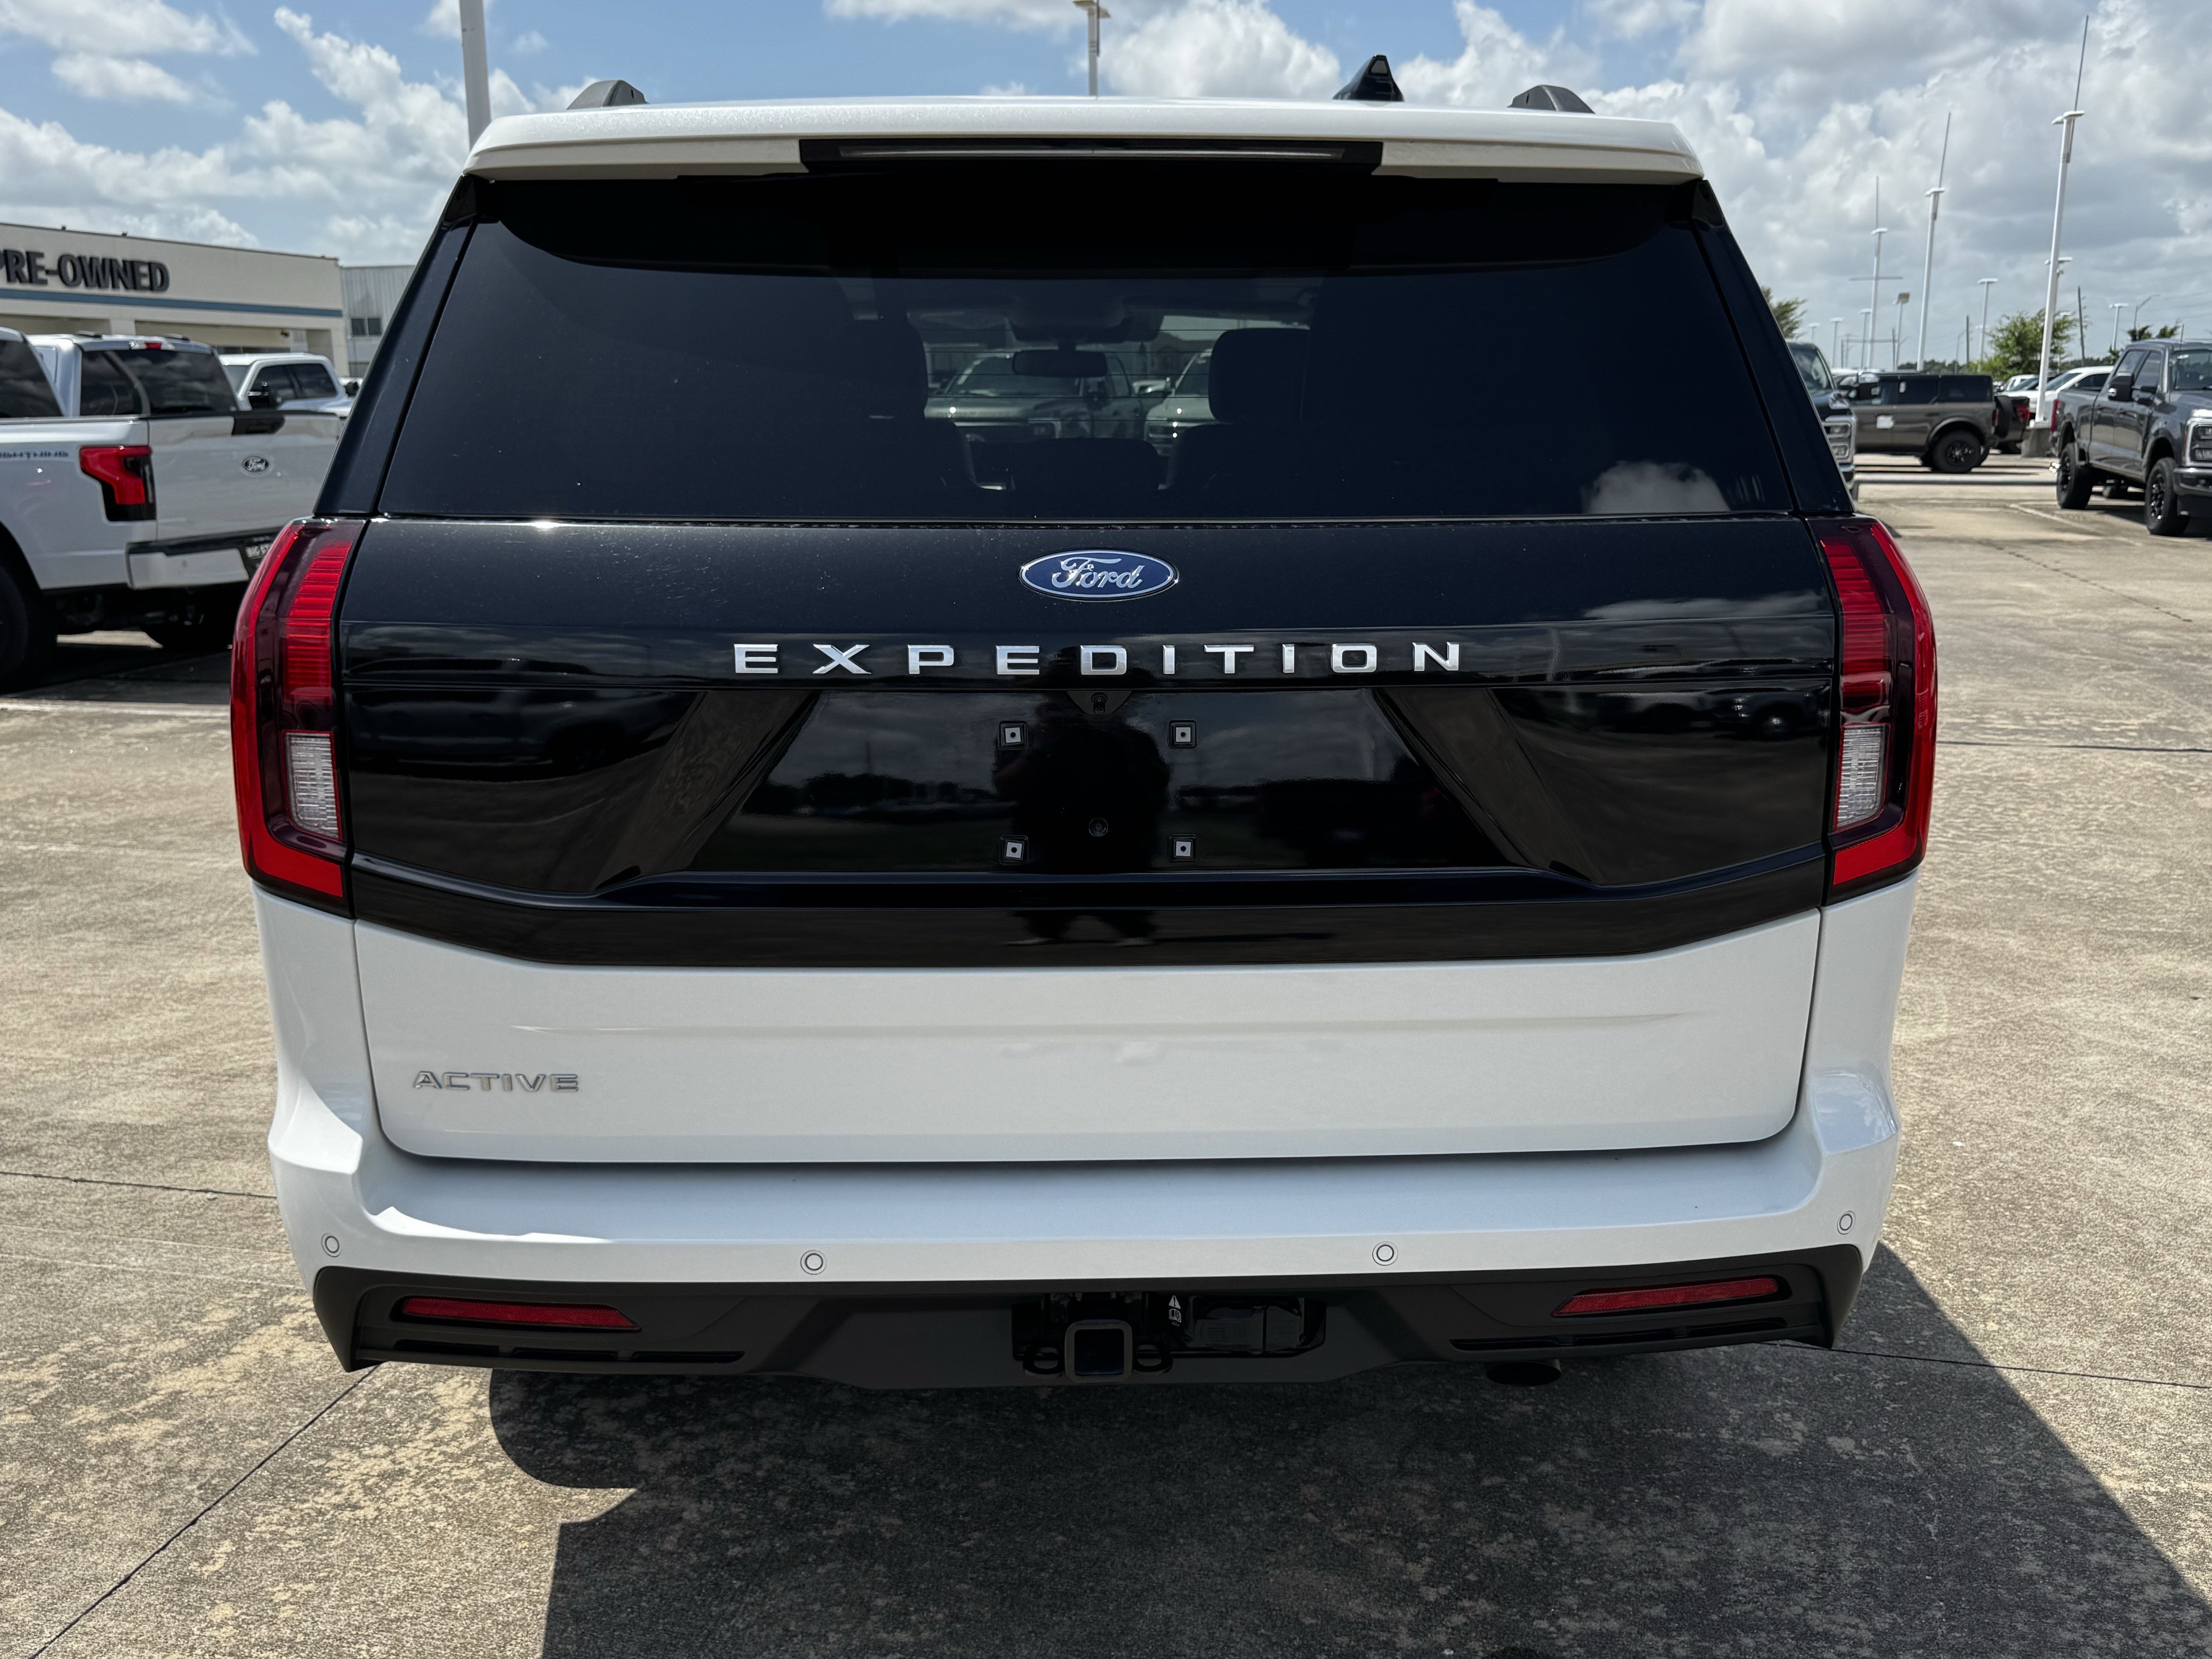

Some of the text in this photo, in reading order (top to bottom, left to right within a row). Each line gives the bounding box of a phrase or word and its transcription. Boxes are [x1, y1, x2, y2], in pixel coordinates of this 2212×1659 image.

[1051, 556, 1145, 588] Ford
[734, 641, 1460, 675] EXPEDITION
[412, 1070, 579, 1092] ACTIVE
